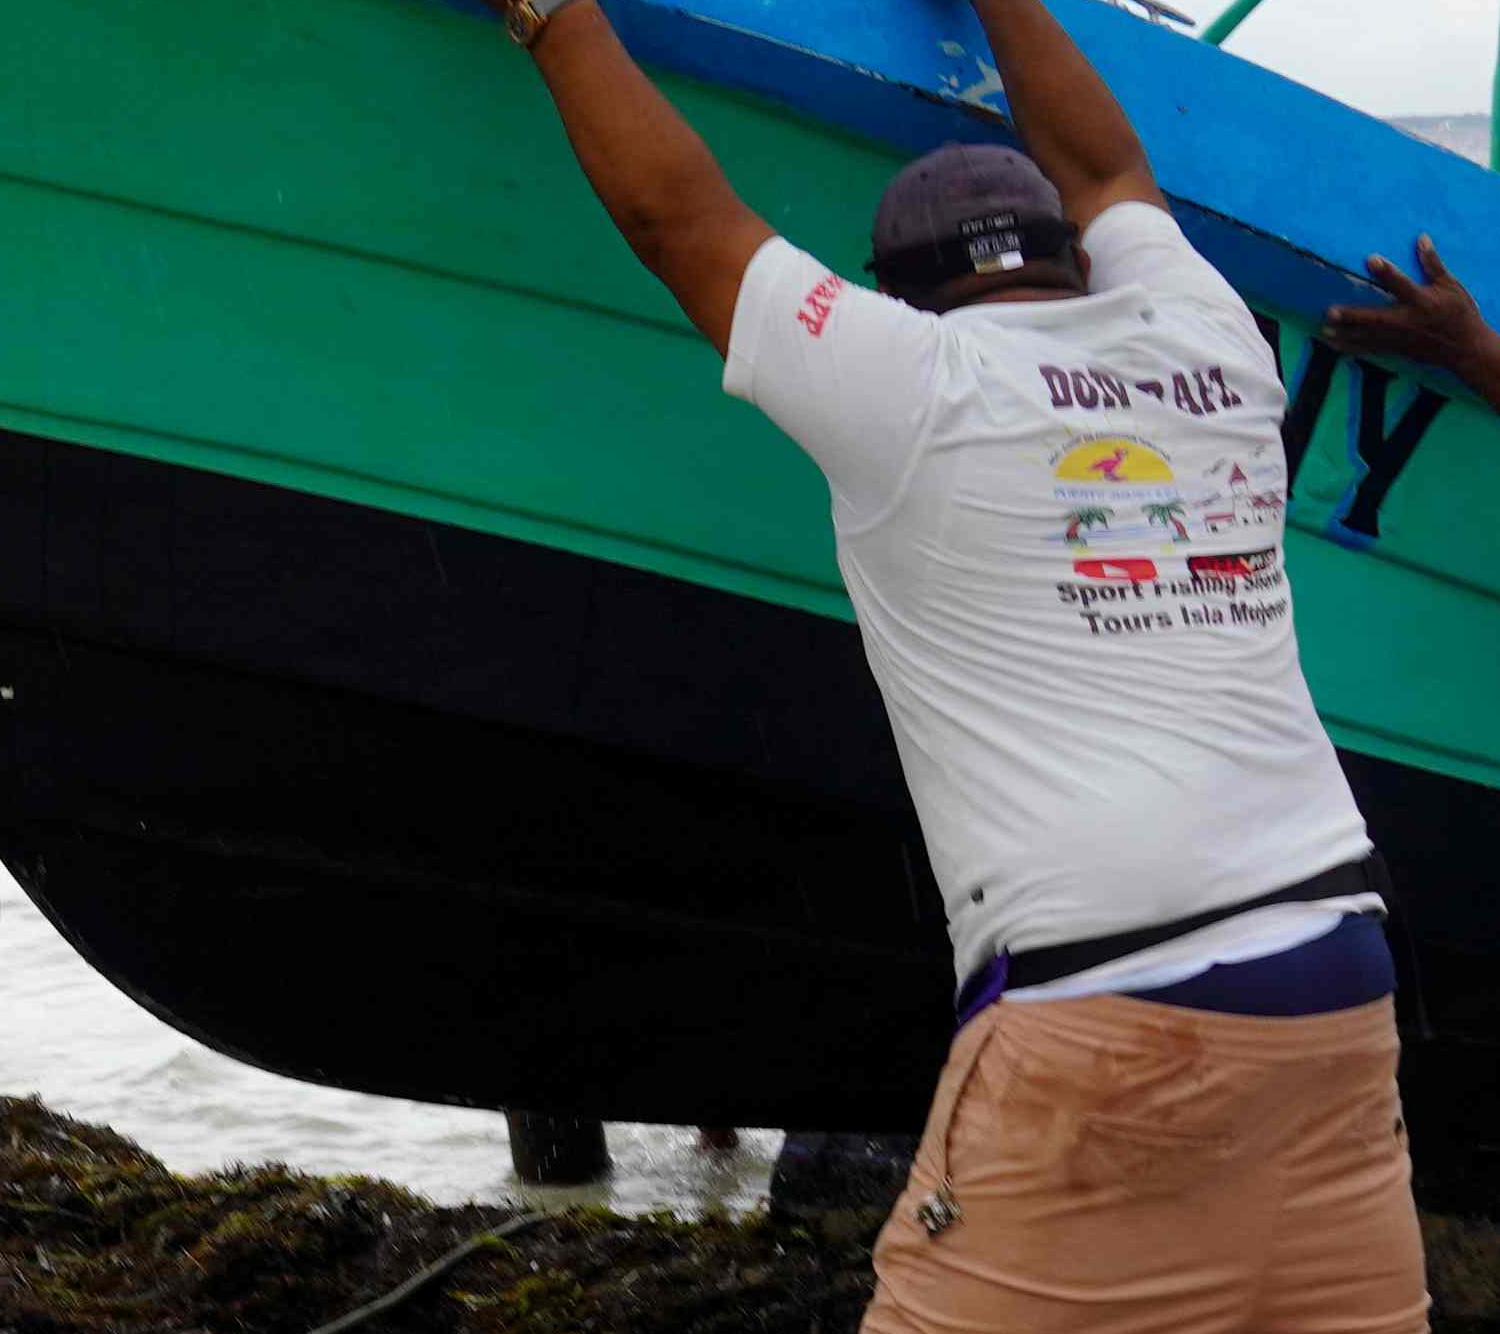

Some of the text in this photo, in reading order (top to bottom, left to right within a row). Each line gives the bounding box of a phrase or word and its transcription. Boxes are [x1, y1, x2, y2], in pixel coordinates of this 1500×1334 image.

[1038, 364, 1132, 409] DON
[1057, 578, 1146, 608] Sport
[1080, 608, 1173, 635] Tours
[1180, 601, 1224, 626] Isla
